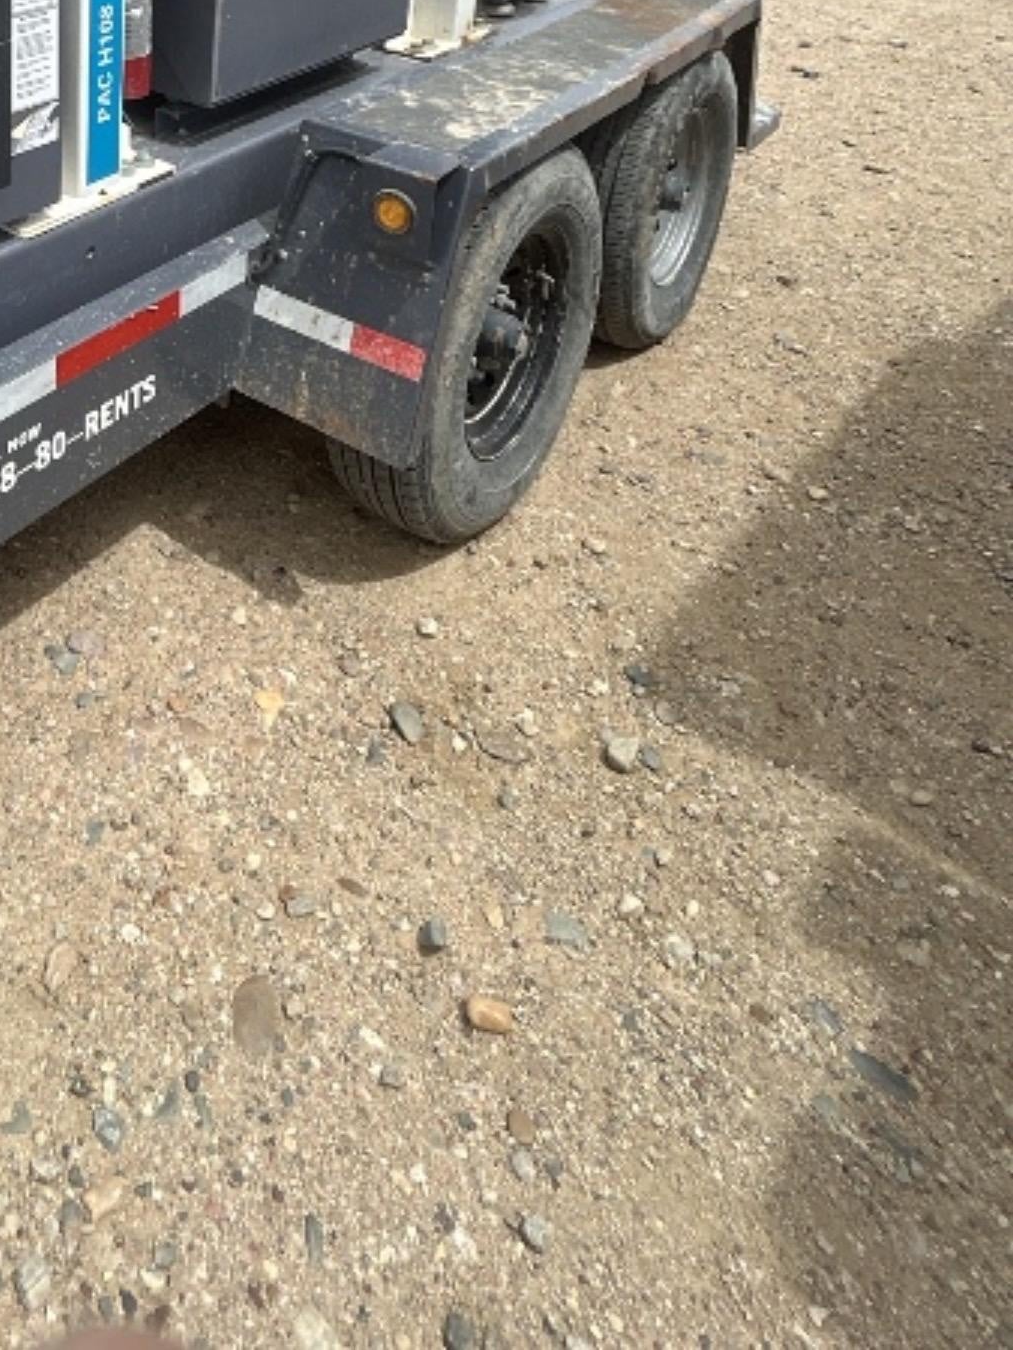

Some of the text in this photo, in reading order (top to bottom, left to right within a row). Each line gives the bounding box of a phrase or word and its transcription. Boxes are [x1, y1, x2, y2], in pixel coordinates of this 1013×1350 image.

[97, 3, 114, 123] PAC H108
[7, 422, 42, 453] NOW
